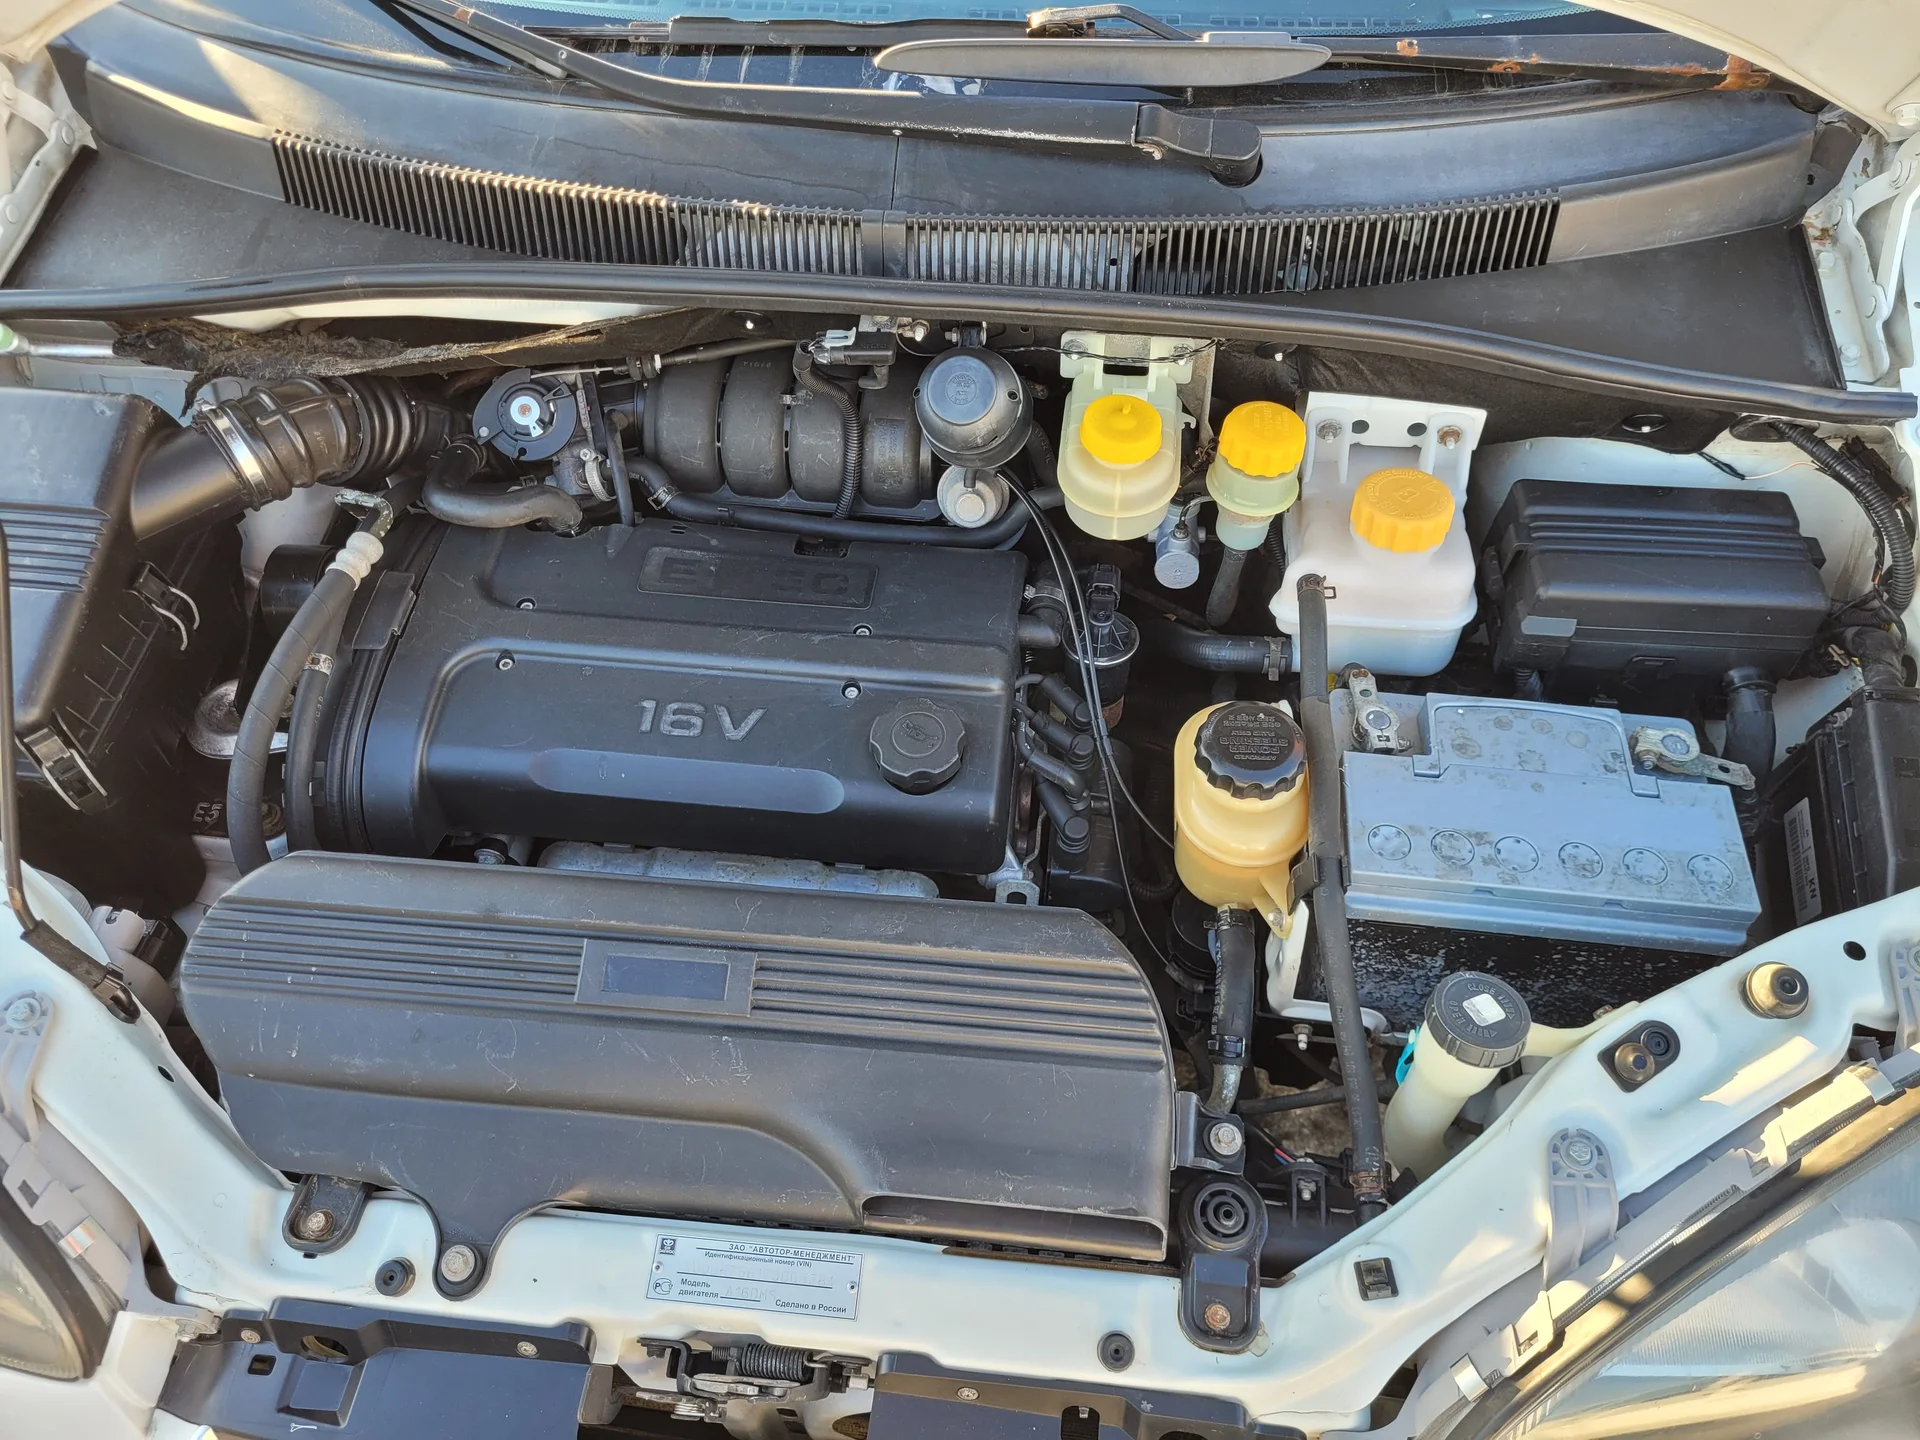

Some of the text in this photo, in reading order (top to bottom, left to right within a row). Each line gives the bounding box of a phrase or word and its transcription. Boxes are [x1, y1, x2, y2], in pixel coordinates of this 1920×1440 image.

[634, 698, 769, 742] 16V
[1219, 736, 1289, 747] STEERING
[1229, 744, 1280, 754] POWER
[1808, 877, 1816, 899] KN
[1467, 982, 1497, 995] CLOSE
[1448, 1000, 1466, 1025] OPEN
[704, 1251, 812, 1268] Идентификационный номер (VIN)
[729, 1243, 856, 1262] ЗАО "АВТОТОР-МЕНЕДЖМЕНТ"
[680, 1278, 711, 1289] Модель
[678, 1288, 719, 1299] двигателя
[775, 1299, 809, 1310] Сделано
[817, 1303, 847, 1313] России
